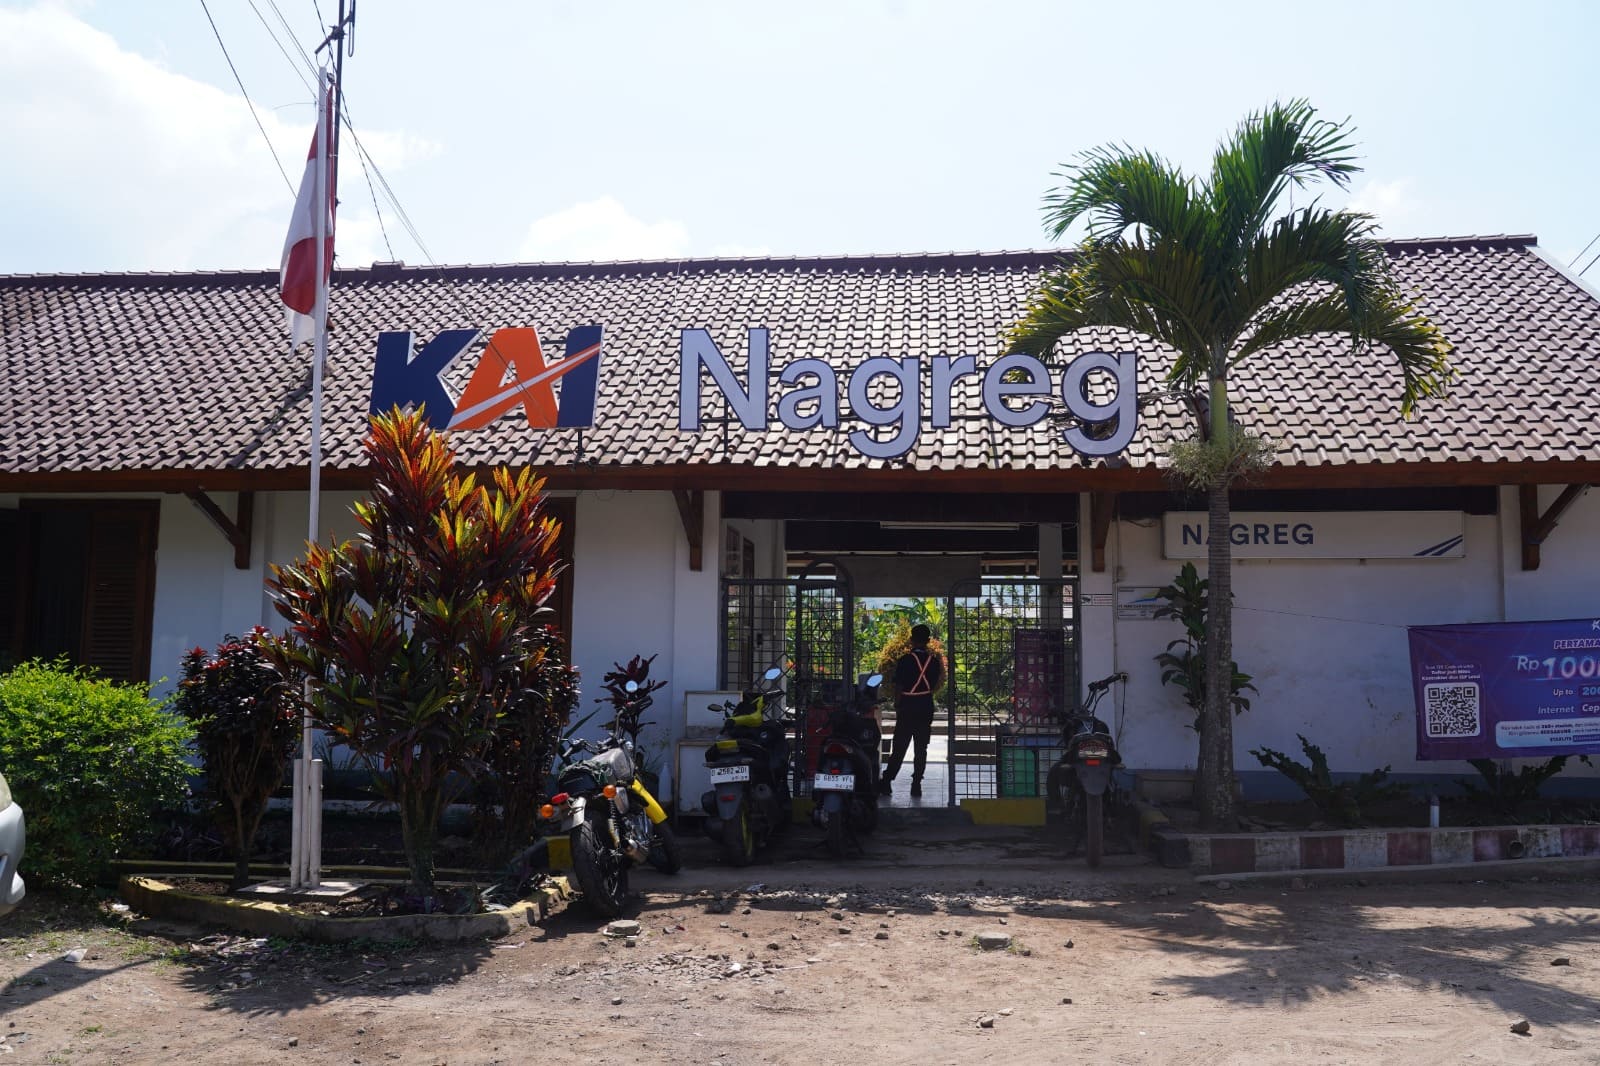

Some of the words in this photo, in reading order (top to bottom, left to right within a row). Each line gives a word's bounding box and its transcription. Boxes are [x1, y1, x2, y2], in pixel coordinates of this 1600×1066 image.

[369, 325, 604, 429] KAI
[679, 327, 1138, 458] Nagreg
[1182, 523, 1314, 545] NGREG
[1516, 655, 1539, 671] Rp
[1553, 688, 1564, 697] Up
[1538, 703, 1575, 714] Internet
